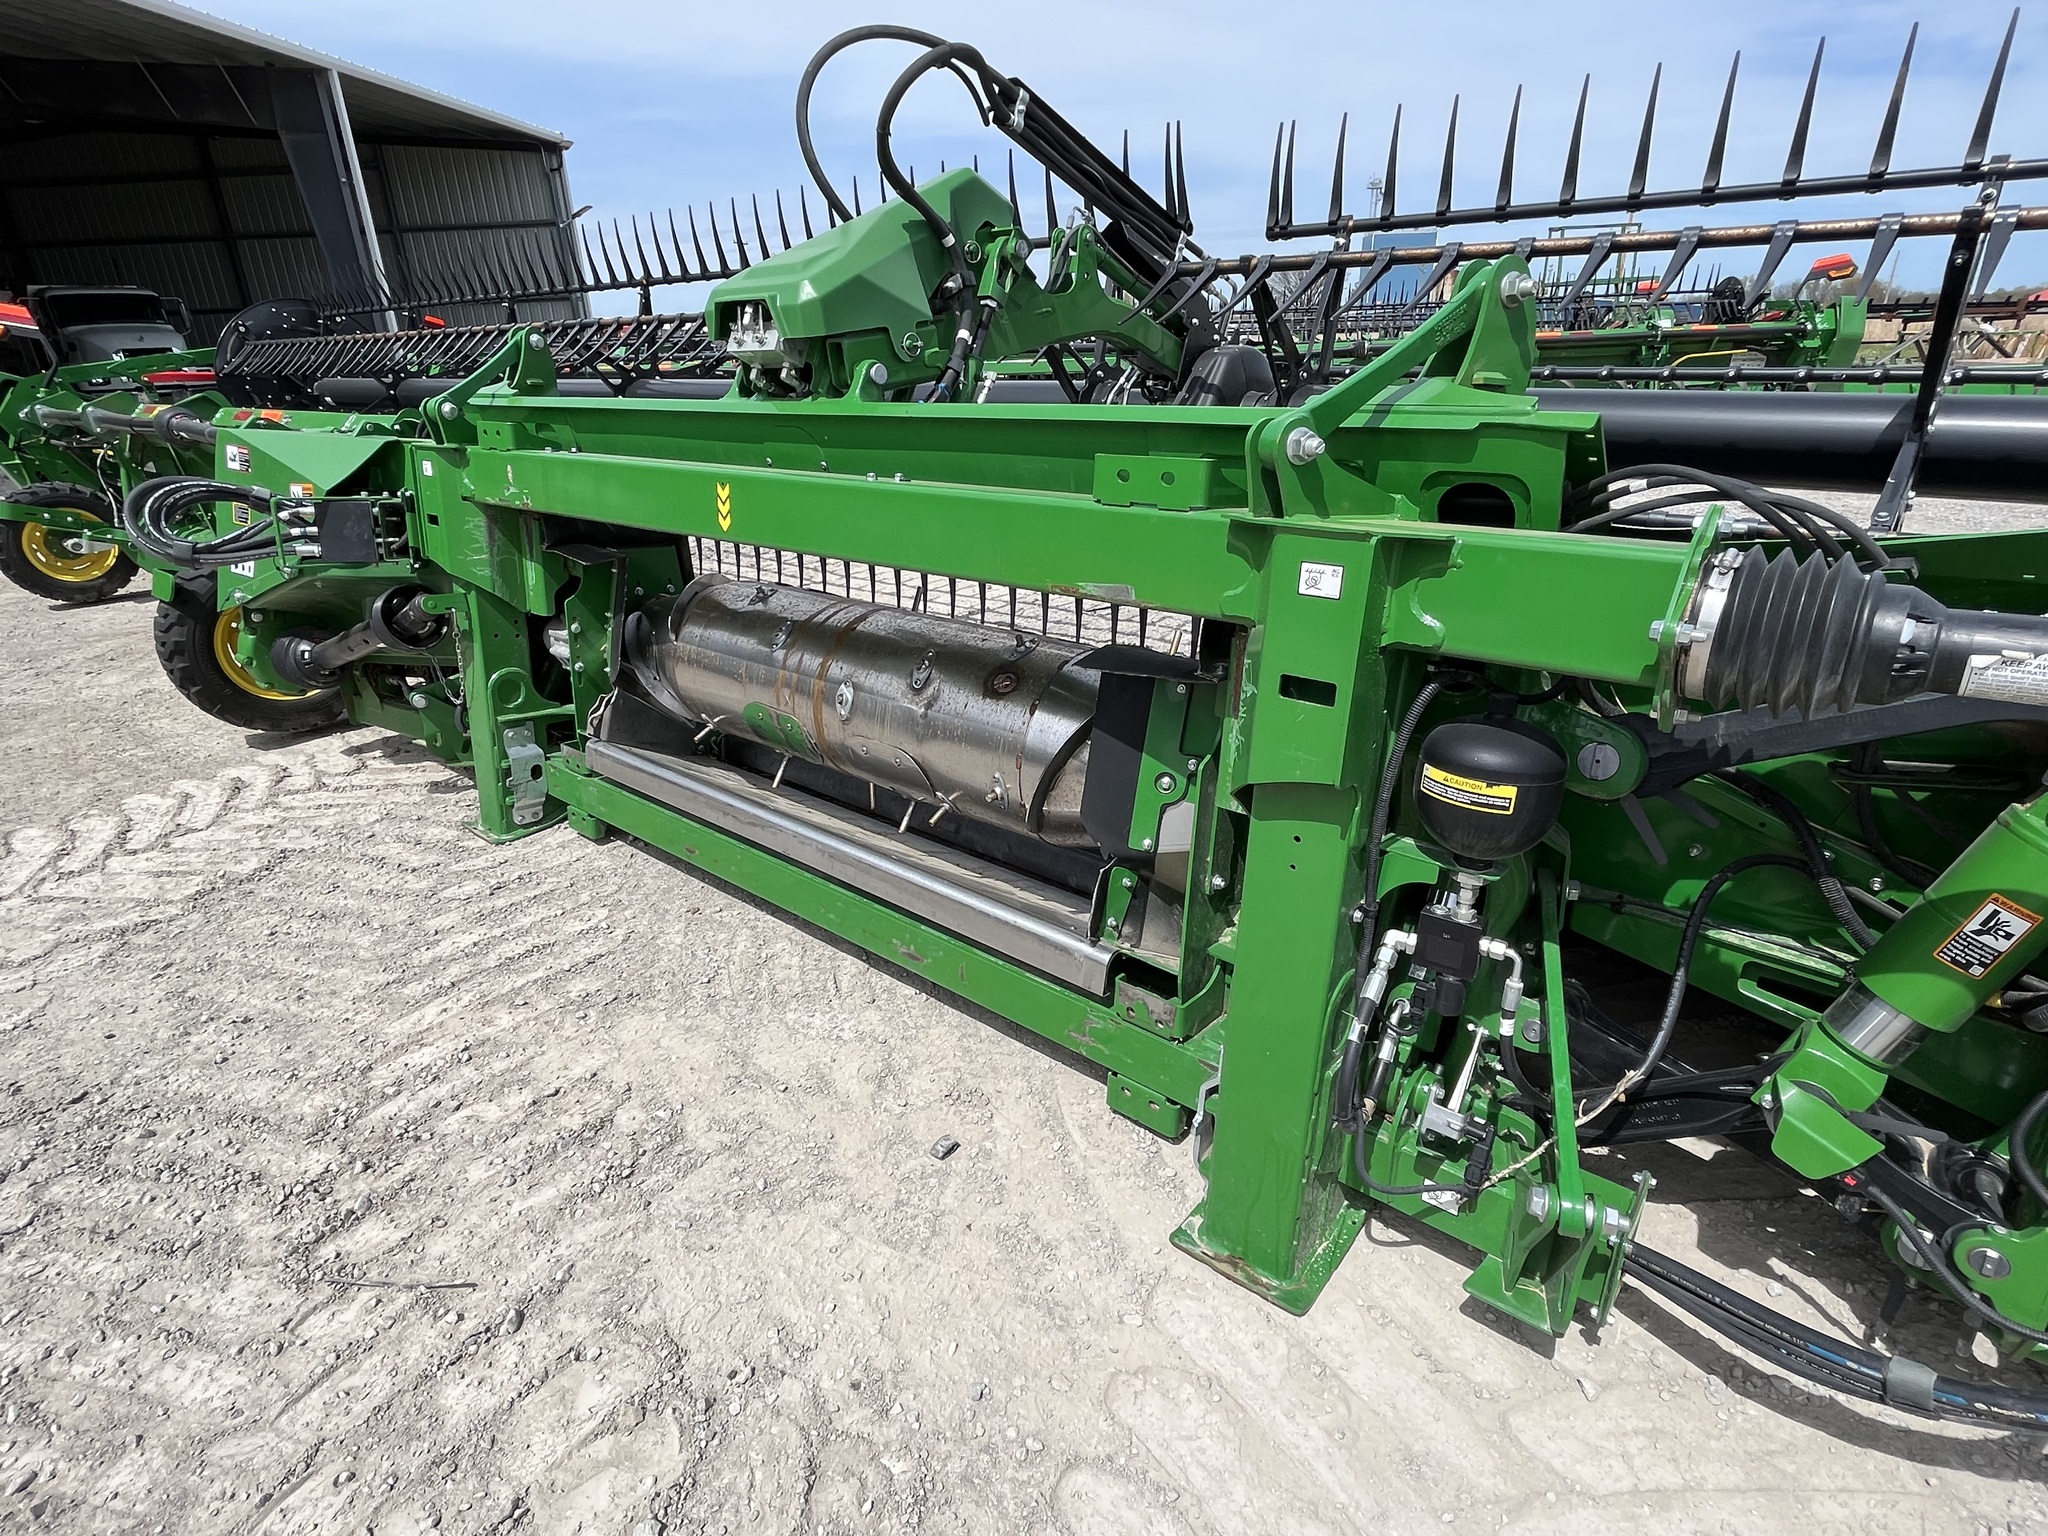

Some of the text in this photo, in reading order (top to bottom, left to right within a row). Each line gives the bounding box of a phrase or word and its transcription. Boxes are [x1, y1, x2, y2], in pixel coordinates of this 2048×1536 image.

[2000, 660, 2033, 668] KEEP
[2010, 668, 2048, 677] OPERATE
[1449, 778, 1484, 791] CAUTION
[1999, 899, 2040, 923] WARNING
